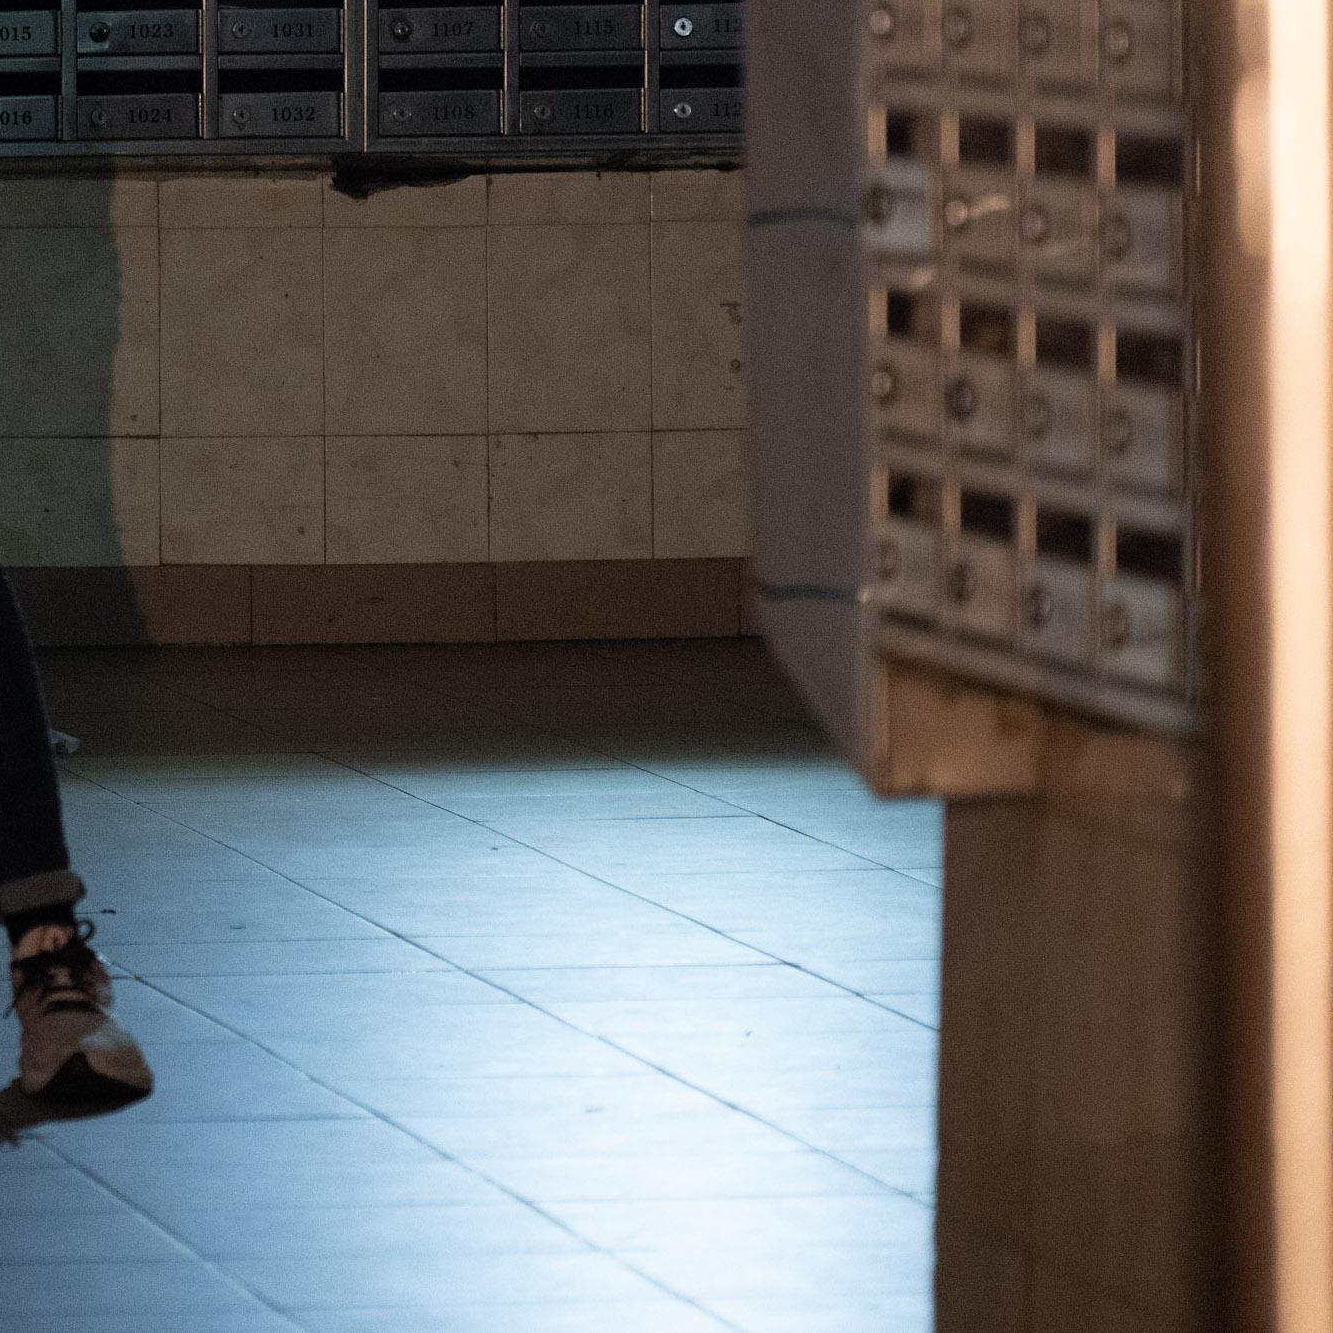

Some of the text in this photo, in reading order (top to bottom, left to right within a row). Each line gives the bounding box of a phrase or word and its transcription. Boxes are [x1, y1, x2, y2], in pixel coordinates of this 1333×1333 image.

[129, 23, 174, 39] 1023
[270, 22, 313, 39] 1031
[432, 21, 474, 37] 1107
[713, 17, 743, 34] 112
[271, 105, 316, 123] 1032
[713, 101, 743, 119] 112
